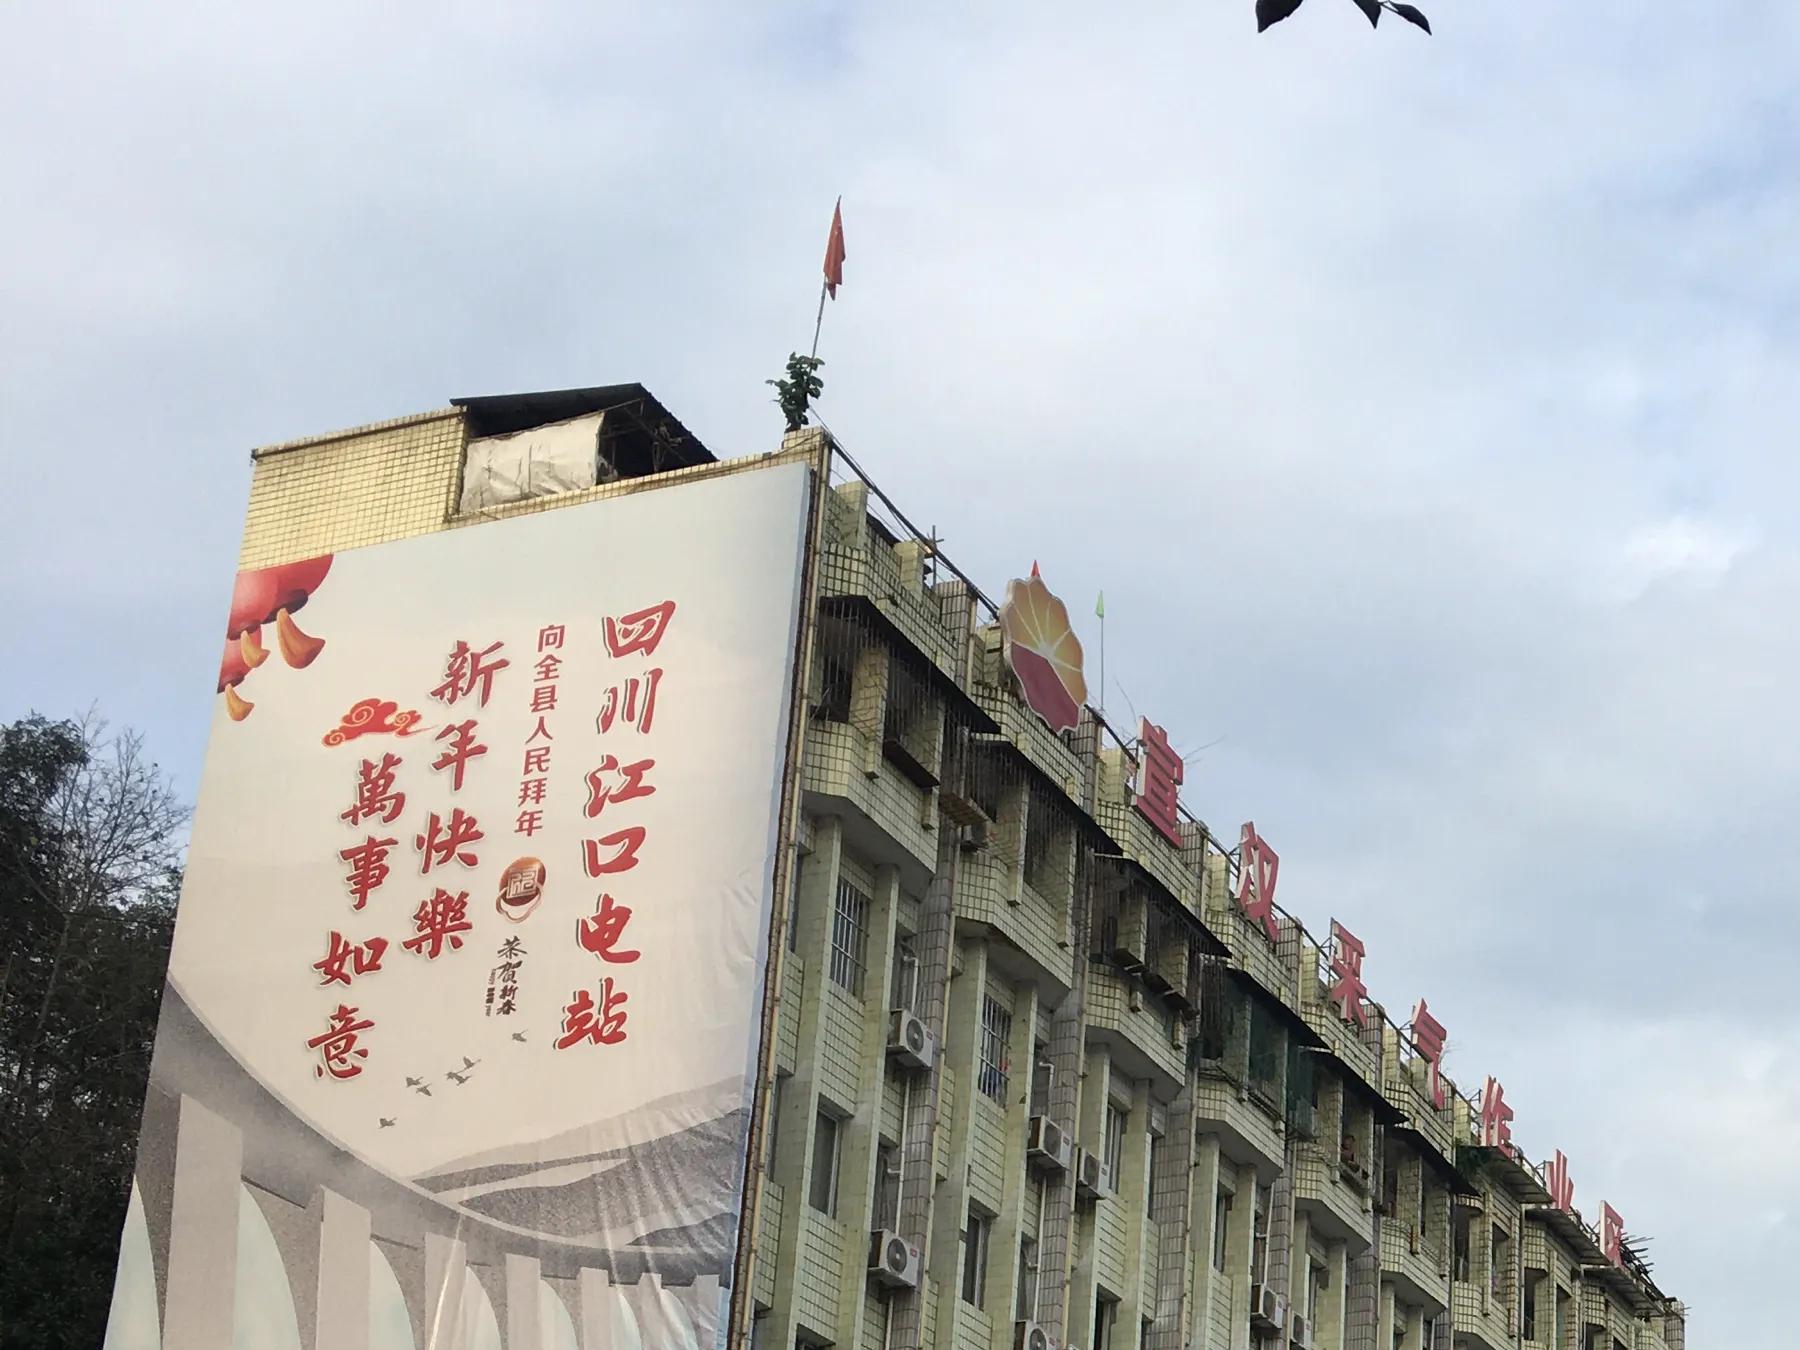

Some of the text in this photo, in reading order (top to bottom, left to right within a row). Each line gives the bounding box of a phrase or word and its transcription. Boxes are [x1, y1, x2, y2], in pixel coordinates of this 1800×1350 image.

[514, 624, 566, 838] 向全县人民拜年
[552, 600, 677, 1051] 四川江口电站
[307, 753, 406, 1080] 萬事如意
